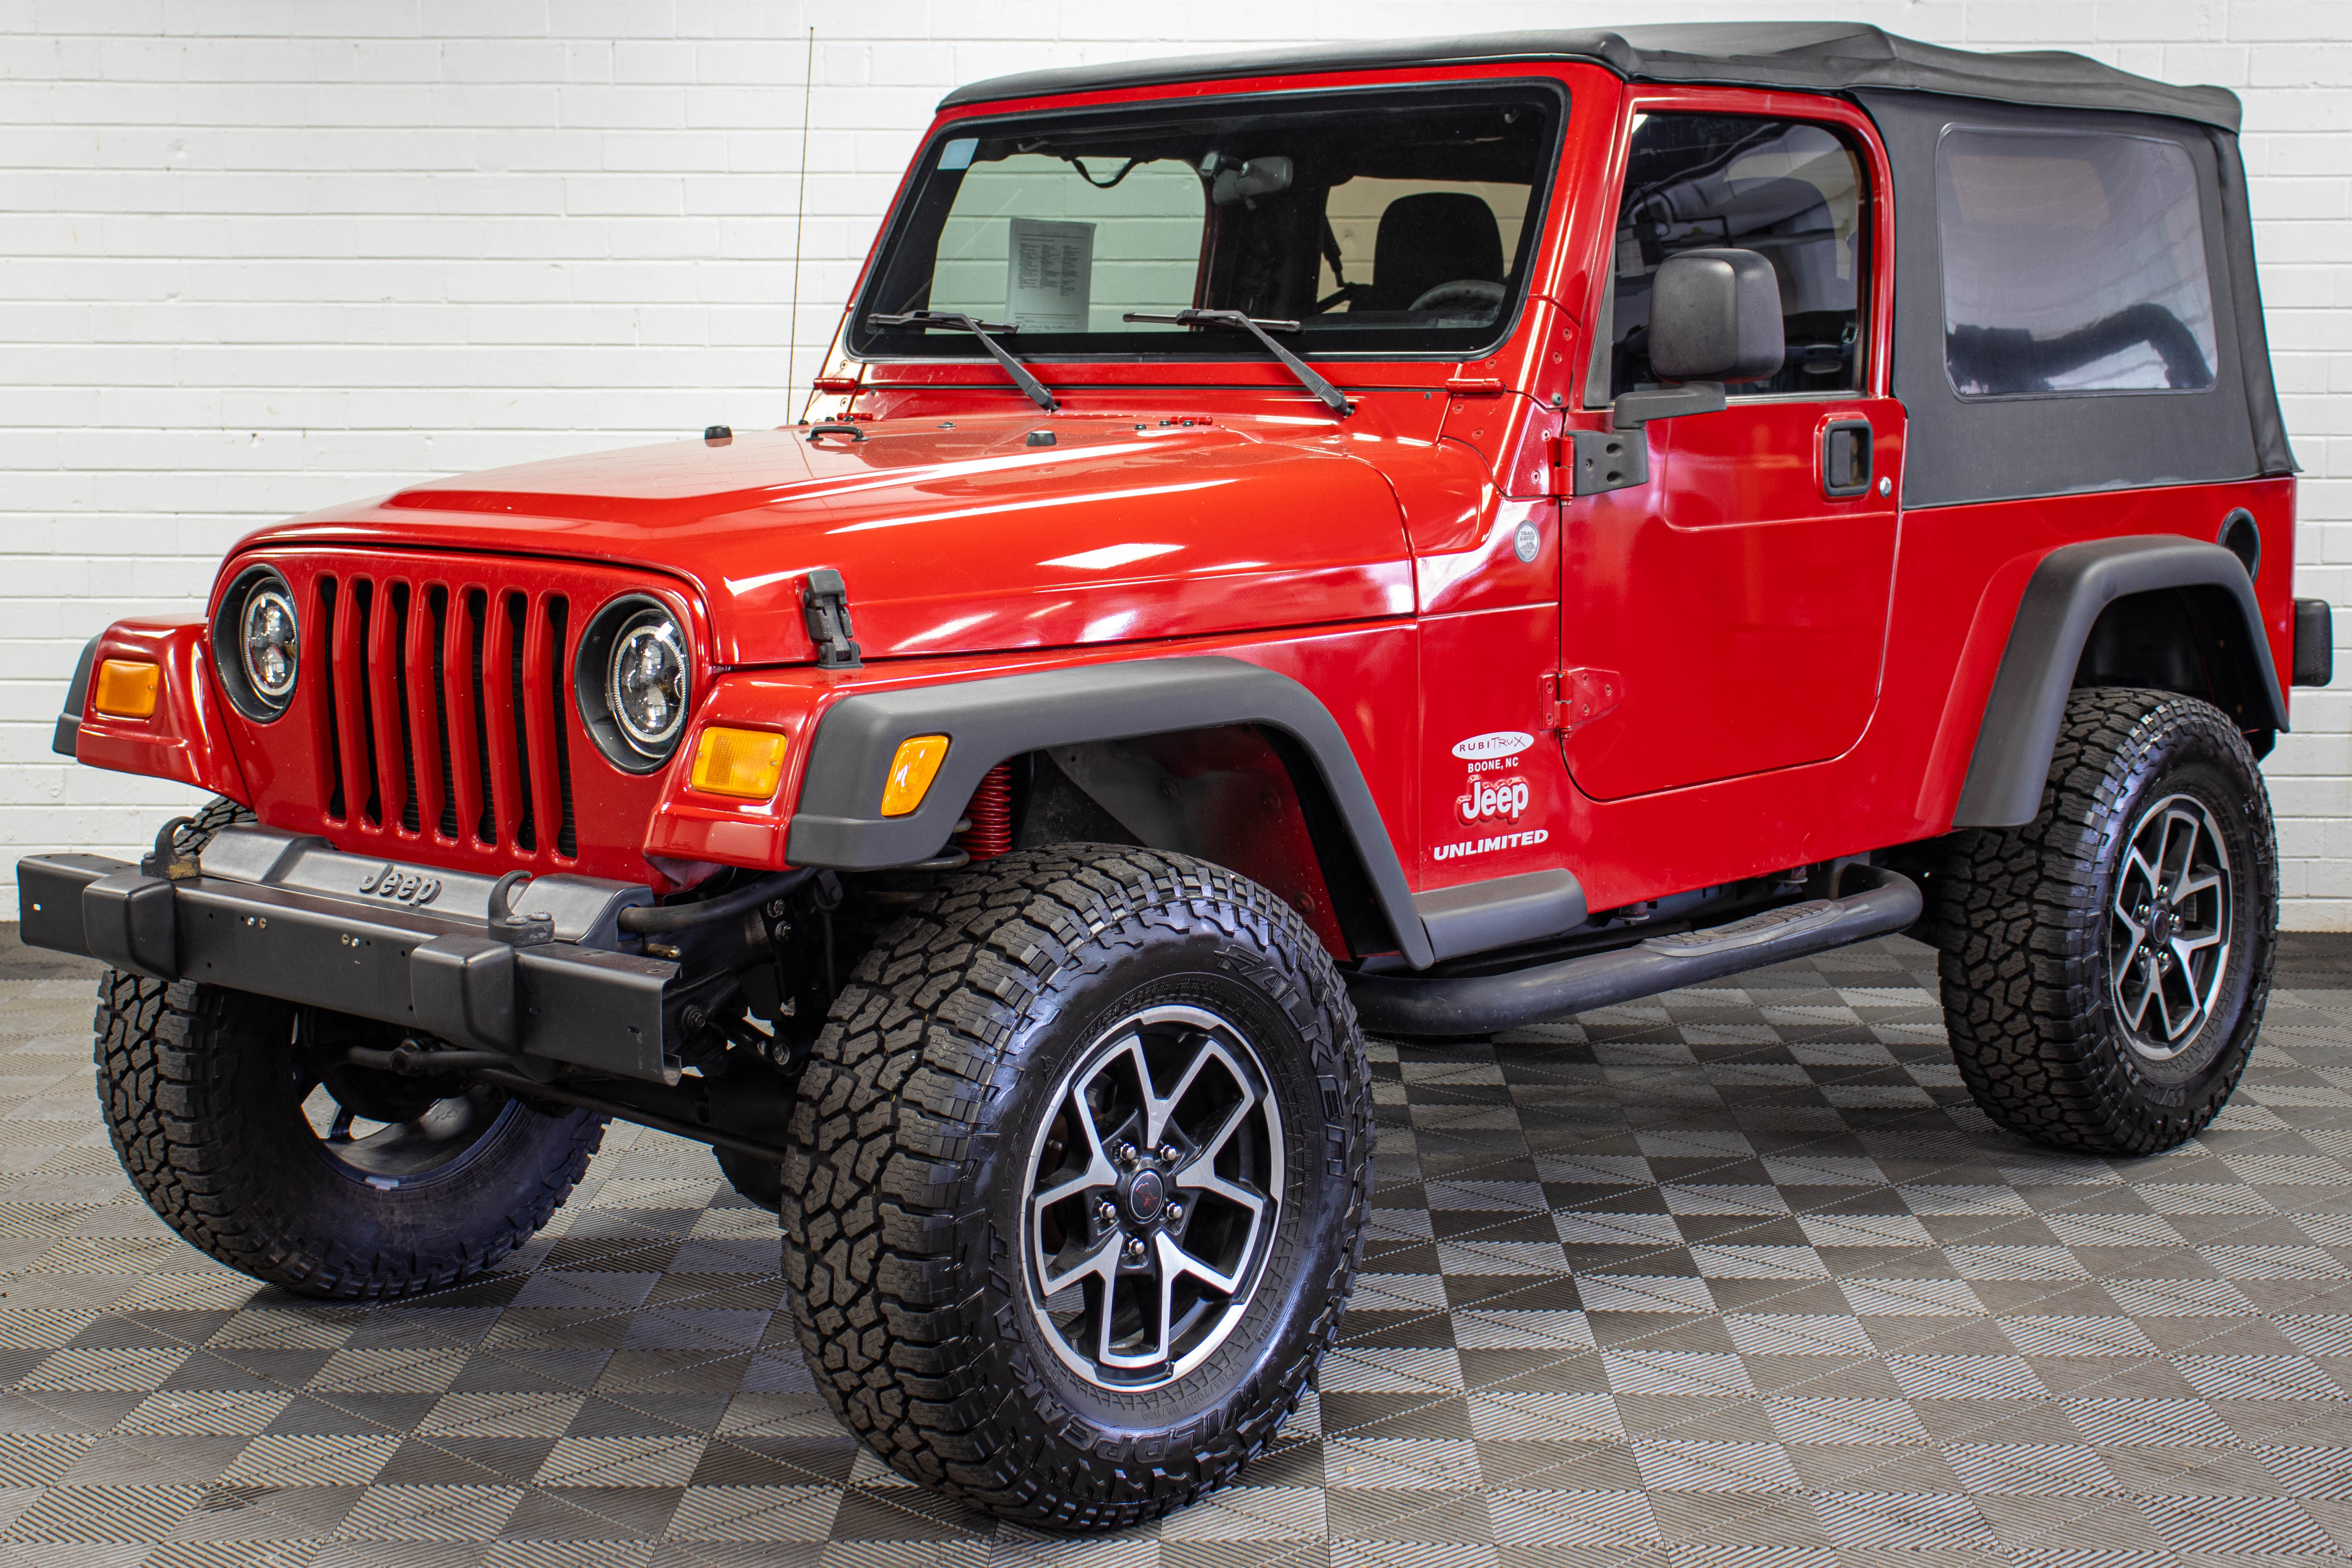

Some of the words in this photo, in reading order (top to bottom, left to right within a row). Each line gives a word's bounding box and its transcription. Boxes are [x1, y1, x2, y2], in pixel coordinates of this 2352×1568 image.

[1468, 759, 1504, 773] BOONE,
[1505, 756, 1519, 768] NC
[1462, 781, 1529, 820] Jeep
[1434, 830, 1549, 860] UNLIMITED
[359, 862, 442, 907] Jeep
[1213, 944, 1347, 1176] FALKEN
[988, 1220, 1023, 1342] A/T
[1009, 1354, 1260, 1464] WILDPEAK
